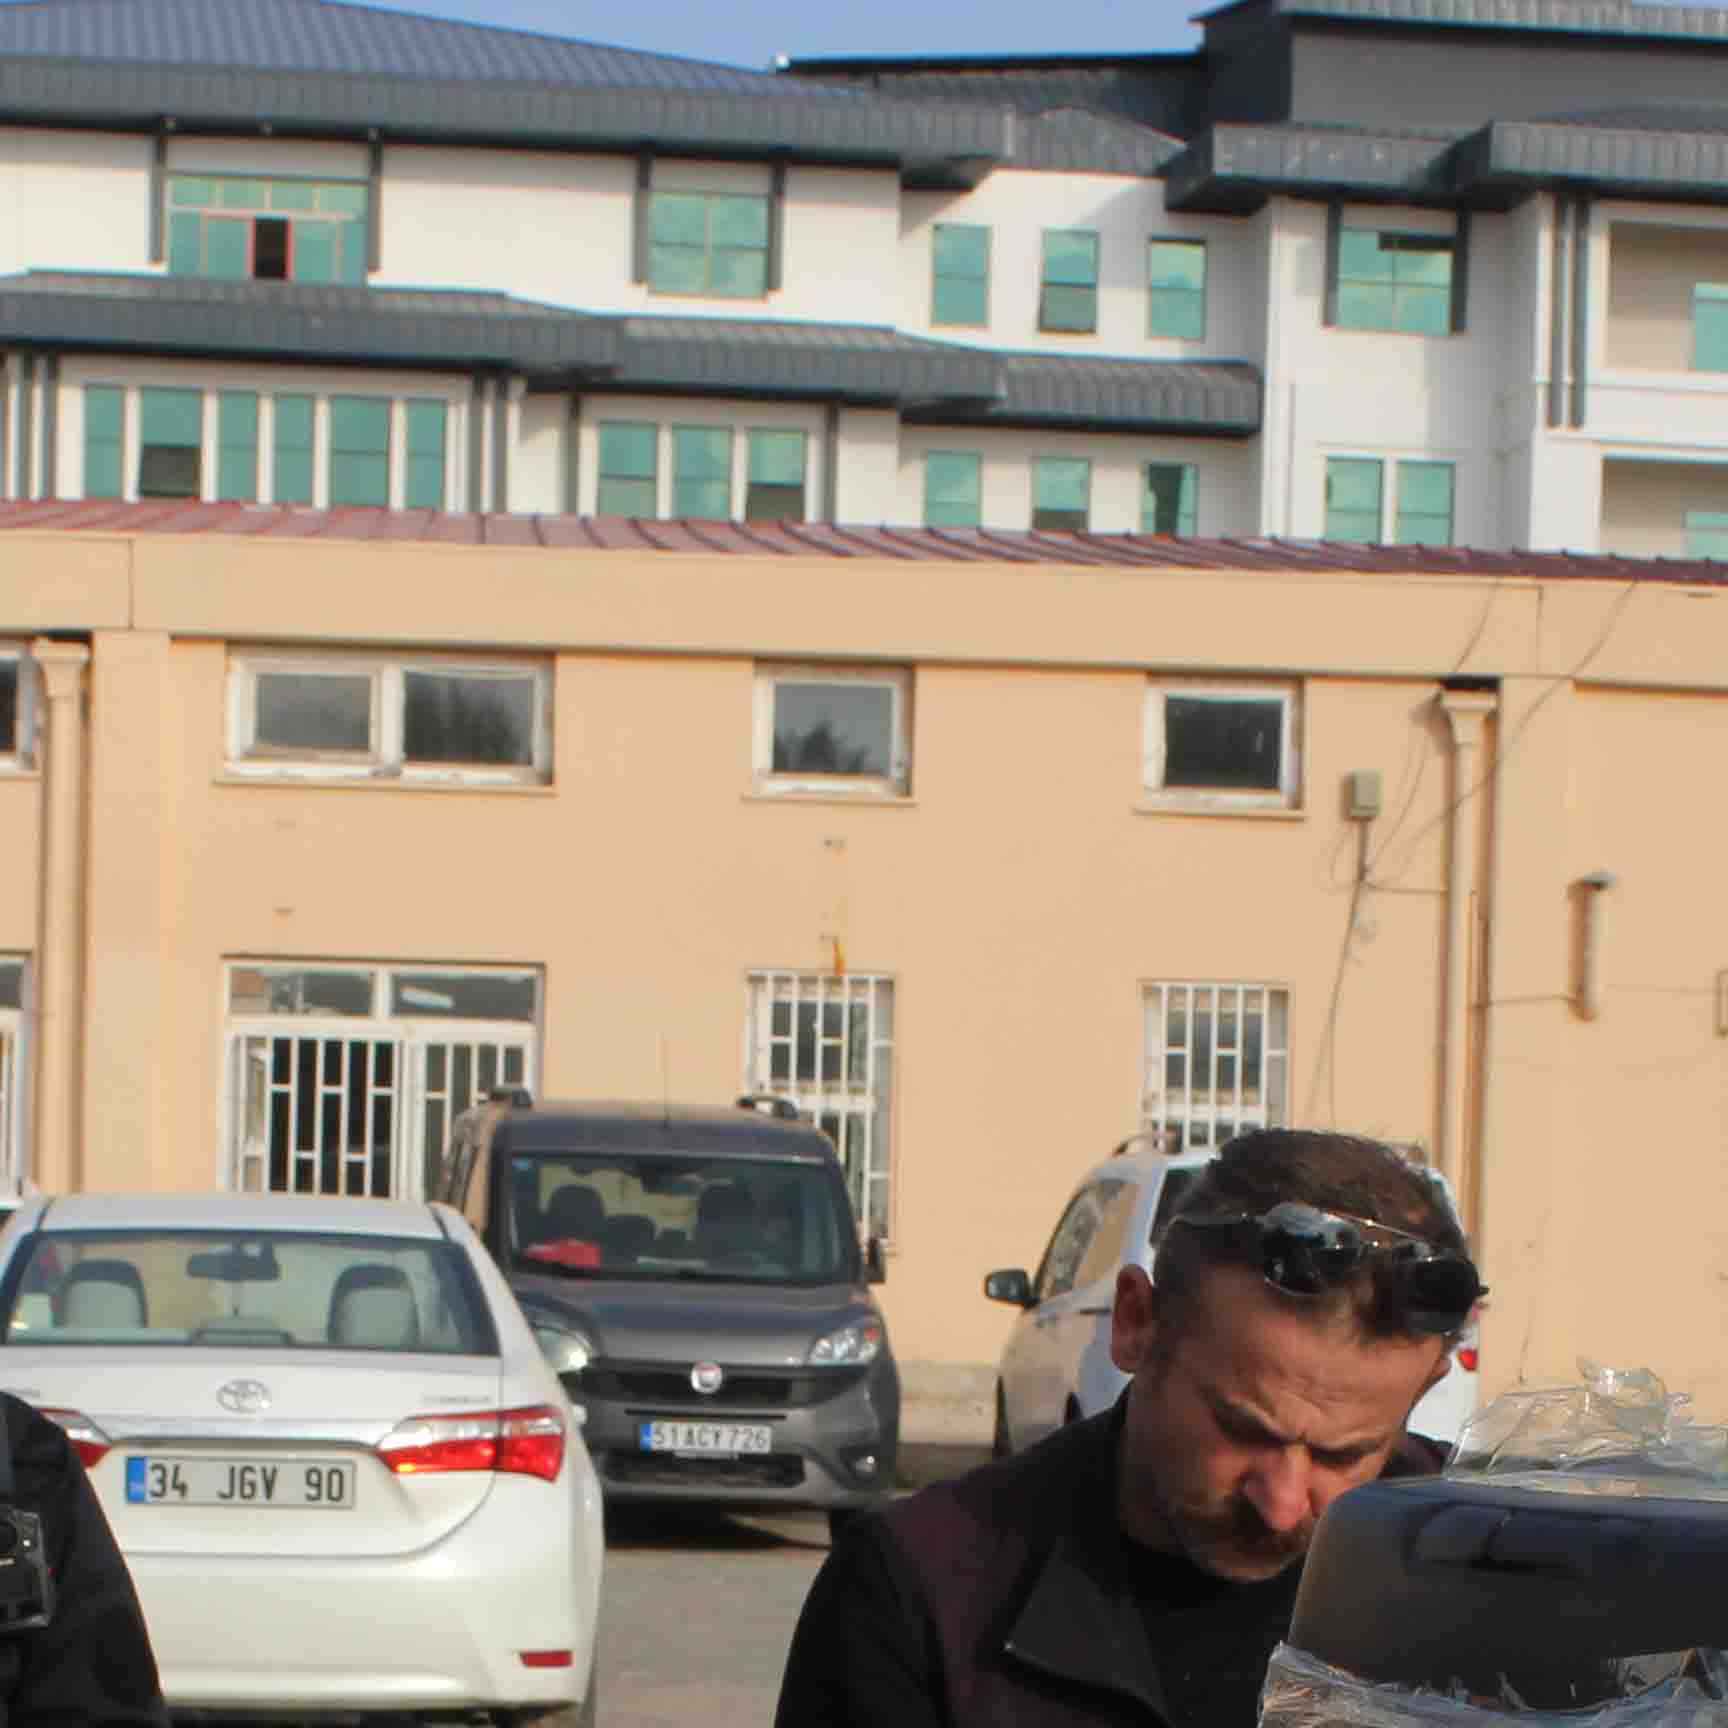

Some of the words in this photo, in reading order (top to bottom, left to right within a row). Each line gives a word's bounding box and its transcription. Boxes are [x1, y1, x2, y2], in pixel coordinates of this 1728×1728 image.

[149, 1463, 189, 1499] 34
[217, 1465, 278, 1500] JGV
[305, 1467, 345, 1502] 90
